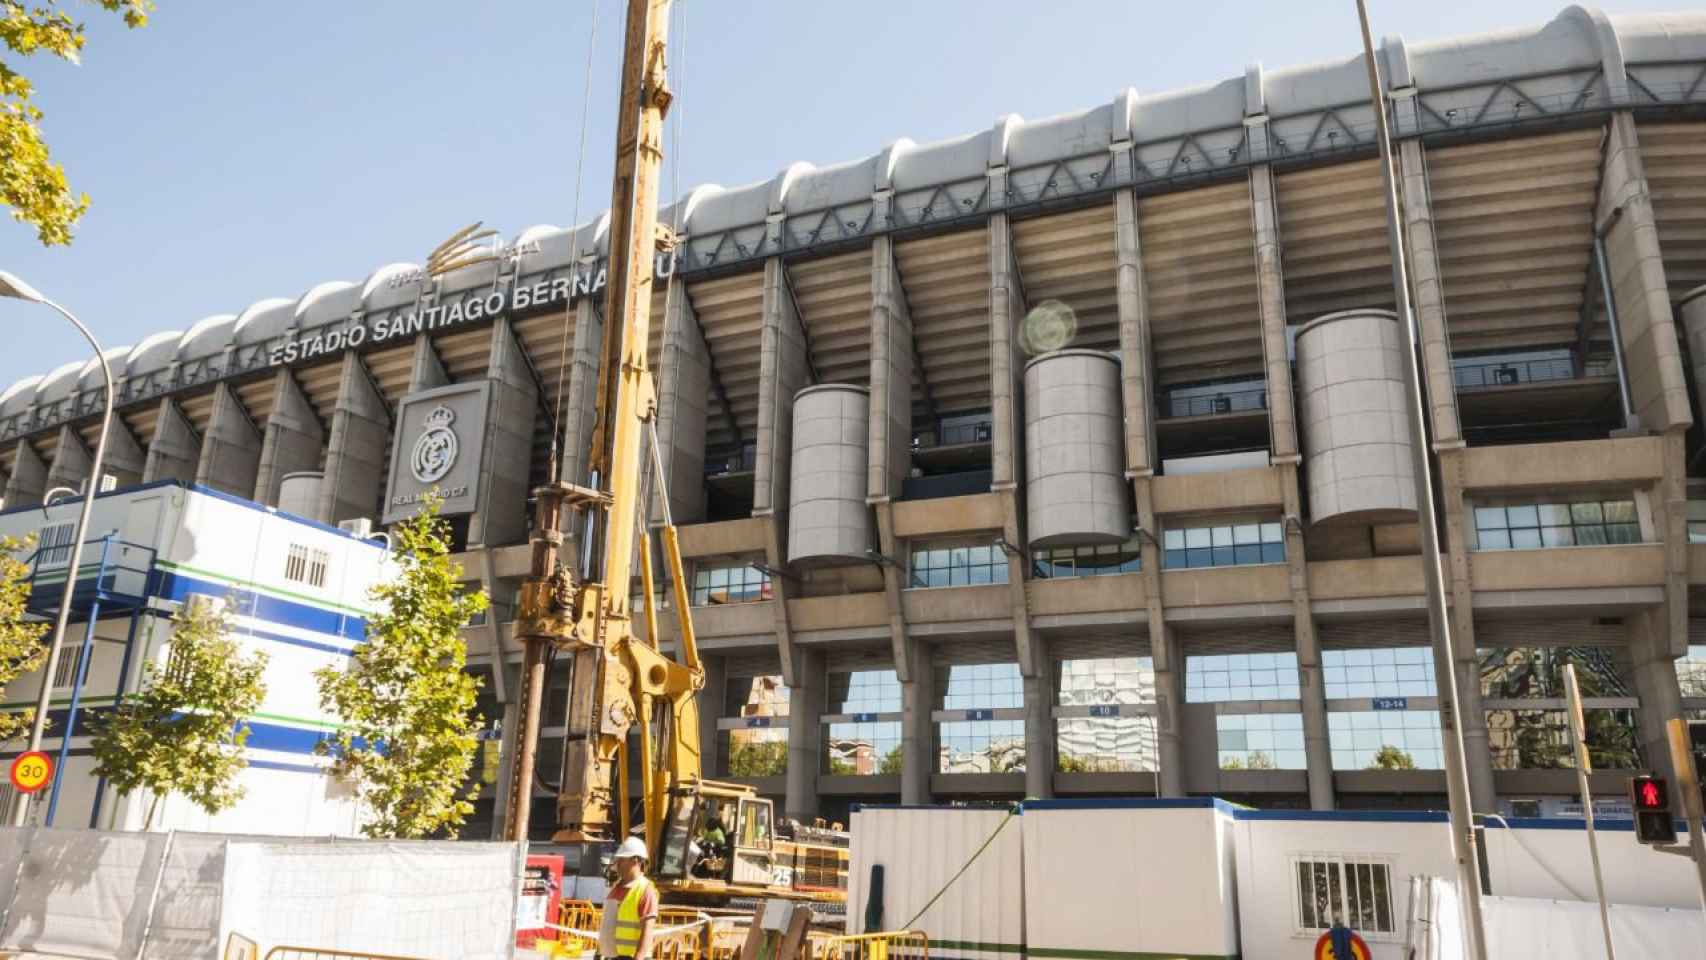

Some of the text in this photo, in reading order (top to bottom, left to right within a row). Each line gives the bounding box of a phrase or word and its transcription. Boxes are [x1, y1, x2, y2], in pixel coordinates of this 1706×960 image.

[373, 291, 504, 342] SANTIAGO
[512, 254, 675, 310] BERNAU
[392, 491, 413, 505] REAL
[20, 764, 44, 779] 30
[773, 870, 792, 886] 25
